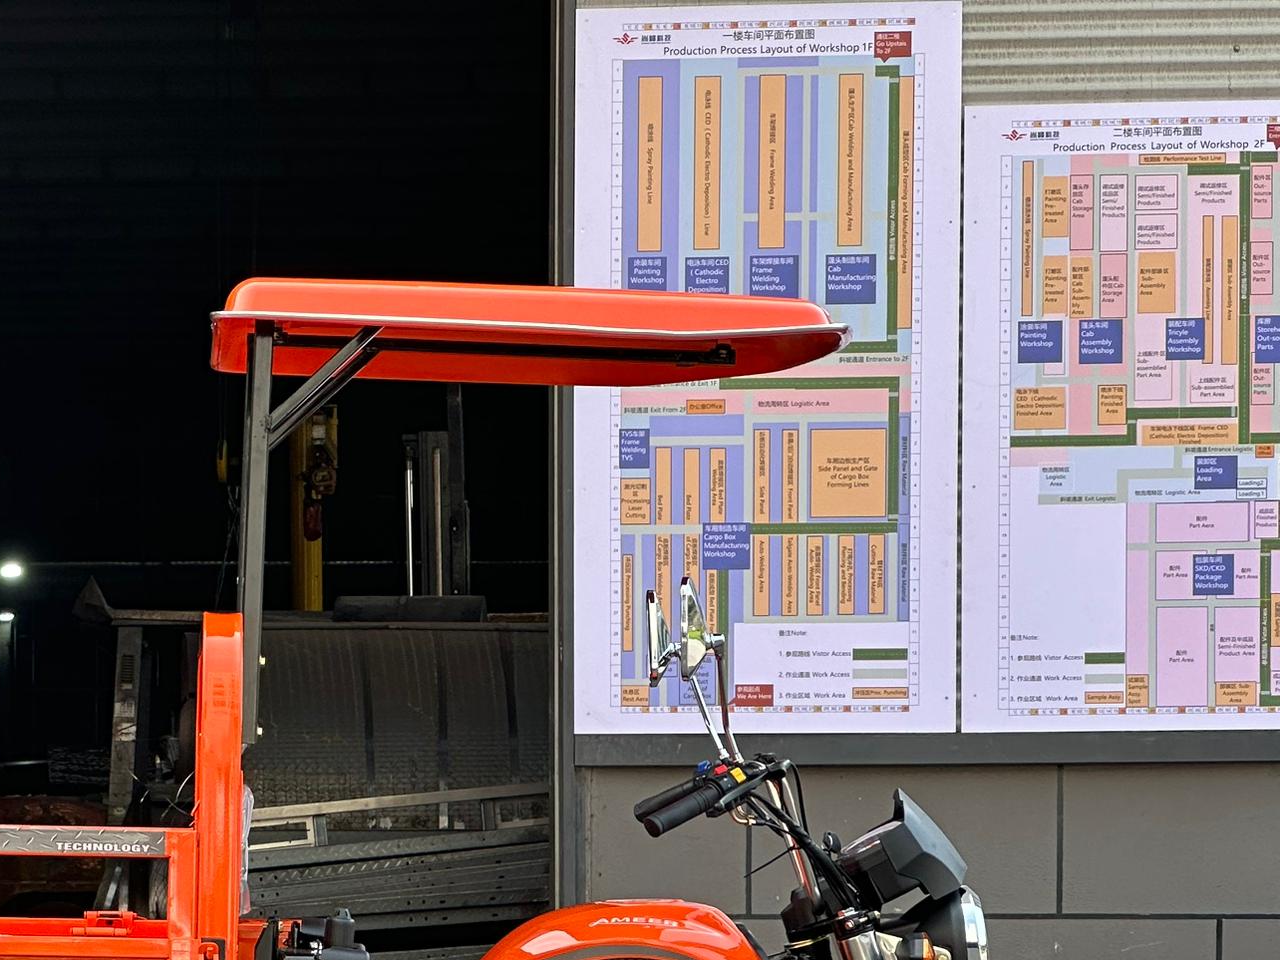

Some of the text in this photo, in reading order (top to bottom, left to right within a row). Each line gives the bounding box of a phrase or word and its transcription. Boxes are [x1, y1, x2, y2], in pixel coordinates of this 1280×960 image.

[723, 29, 815, 41] 一楼车间平面布置图
[664, 42, 873, 56] Production Process Layout of Workshop 1F
[1113, 126, 1202, 138] 二楼车间平面布置图
[1053, 139, 1265, 151] Production Process Layout of Workshop 2F
[630, 276, 664, 284] Workshop
[752, 275, 780, 284] Welding
[828, 274, 876, 282] Manufacturing
[752, 284, 786, 292] Workshop
[791, 400, 814, 408] Logistic
[56, 842, 150, 852] TECHNOLOGY
[588, 917, 684, 928] AMEER
